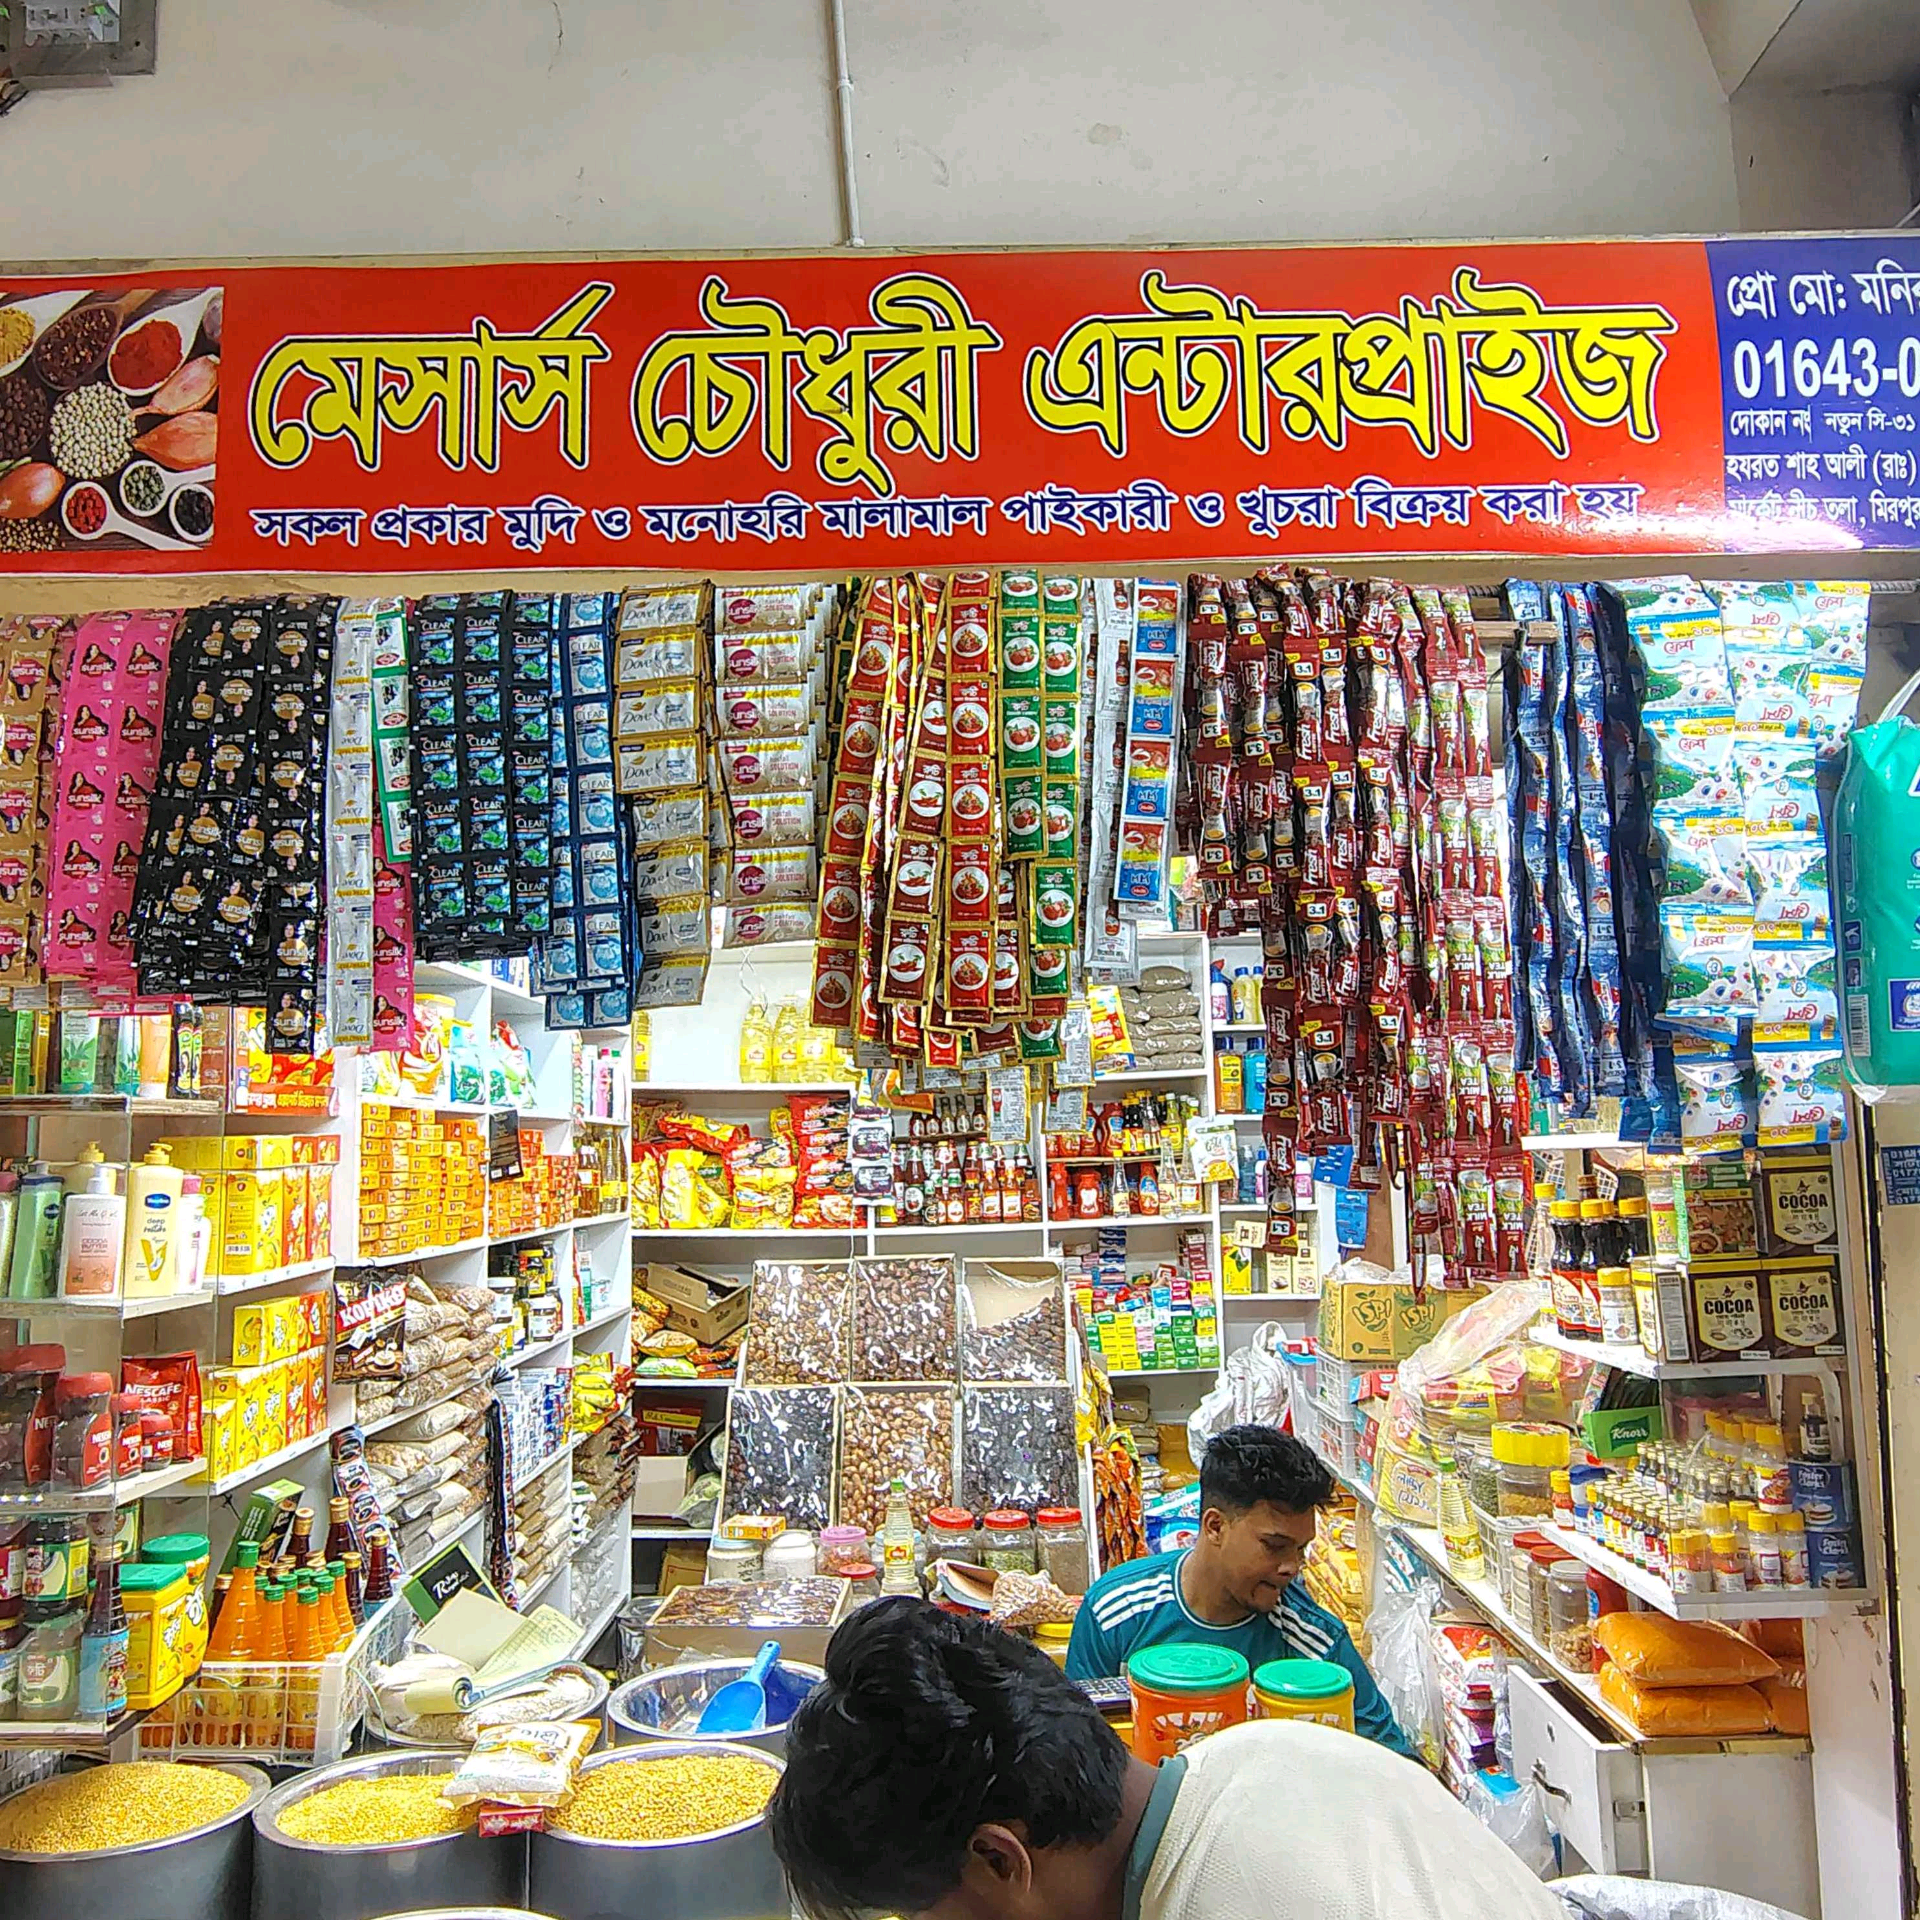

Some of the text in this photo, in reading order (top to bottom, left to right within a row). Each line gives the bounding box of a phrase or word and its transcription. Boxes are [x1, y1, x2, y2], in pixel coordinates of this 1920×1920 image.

[1850, 258, 1920, 316] মনি
[1733, 336, 1920, 398] 01643-0
[250, 266, 1676, 496] মেসার্স চৌধুরী এন্টারপ্রাইজ
[1730, 407, 1788, 437] দোকান
[1824, 411, 1864, 437] নতুন
[1724, 454, 1781, 482] হযরত
[1784, 451, 1822, 482] শাহ
[1823, 443, 1868, 480] আলী
[252, 476, 1645, 551] সকল প্রকার মুদি ও মনোহরি মালামাল পাইকারী ও খুচরা বিক্রয় করা হয়
[421, 621, 451, 633] CLEAR
[466, 618, 496, 629] CLEAR
[514, 634, 545, 646] CLEAR
[420, 677, 450, 690] CLEAR
[465, 674, 496, 687] CLEAR
[514, 693, 545, 704] CLEAR
[422, 738, 452, 752] CLEAR
[467, 736, 499, 748] CLEAR
[514, 755, 545, 766] CLEAR
[428, 802, 458, 815] CLEAR
[472, 800, 502, 812] CLEAR
[516, 817, 546, 830] CLEAR
[431, 867, 460, 880] CLEAR
[475, 863, 506, 876] CLEAR
[516, 881, 546, 894] CLEAR
[1778, 1193, 1829, 1210] COCOA
[339, 1285, 407, 1328] KOPIKO
[1703, 1298, 1756, 1315] COCOA
[1778, 1293, 1830, 1310] COCOA
[1351, 1298, 1392, 1327] ISPI
[1400, 1303, 1436, 1329] ISPI
[124, 1382, 183, 1399] NESCAFE
[1610, 1424, 1650, 1441] Knorr
